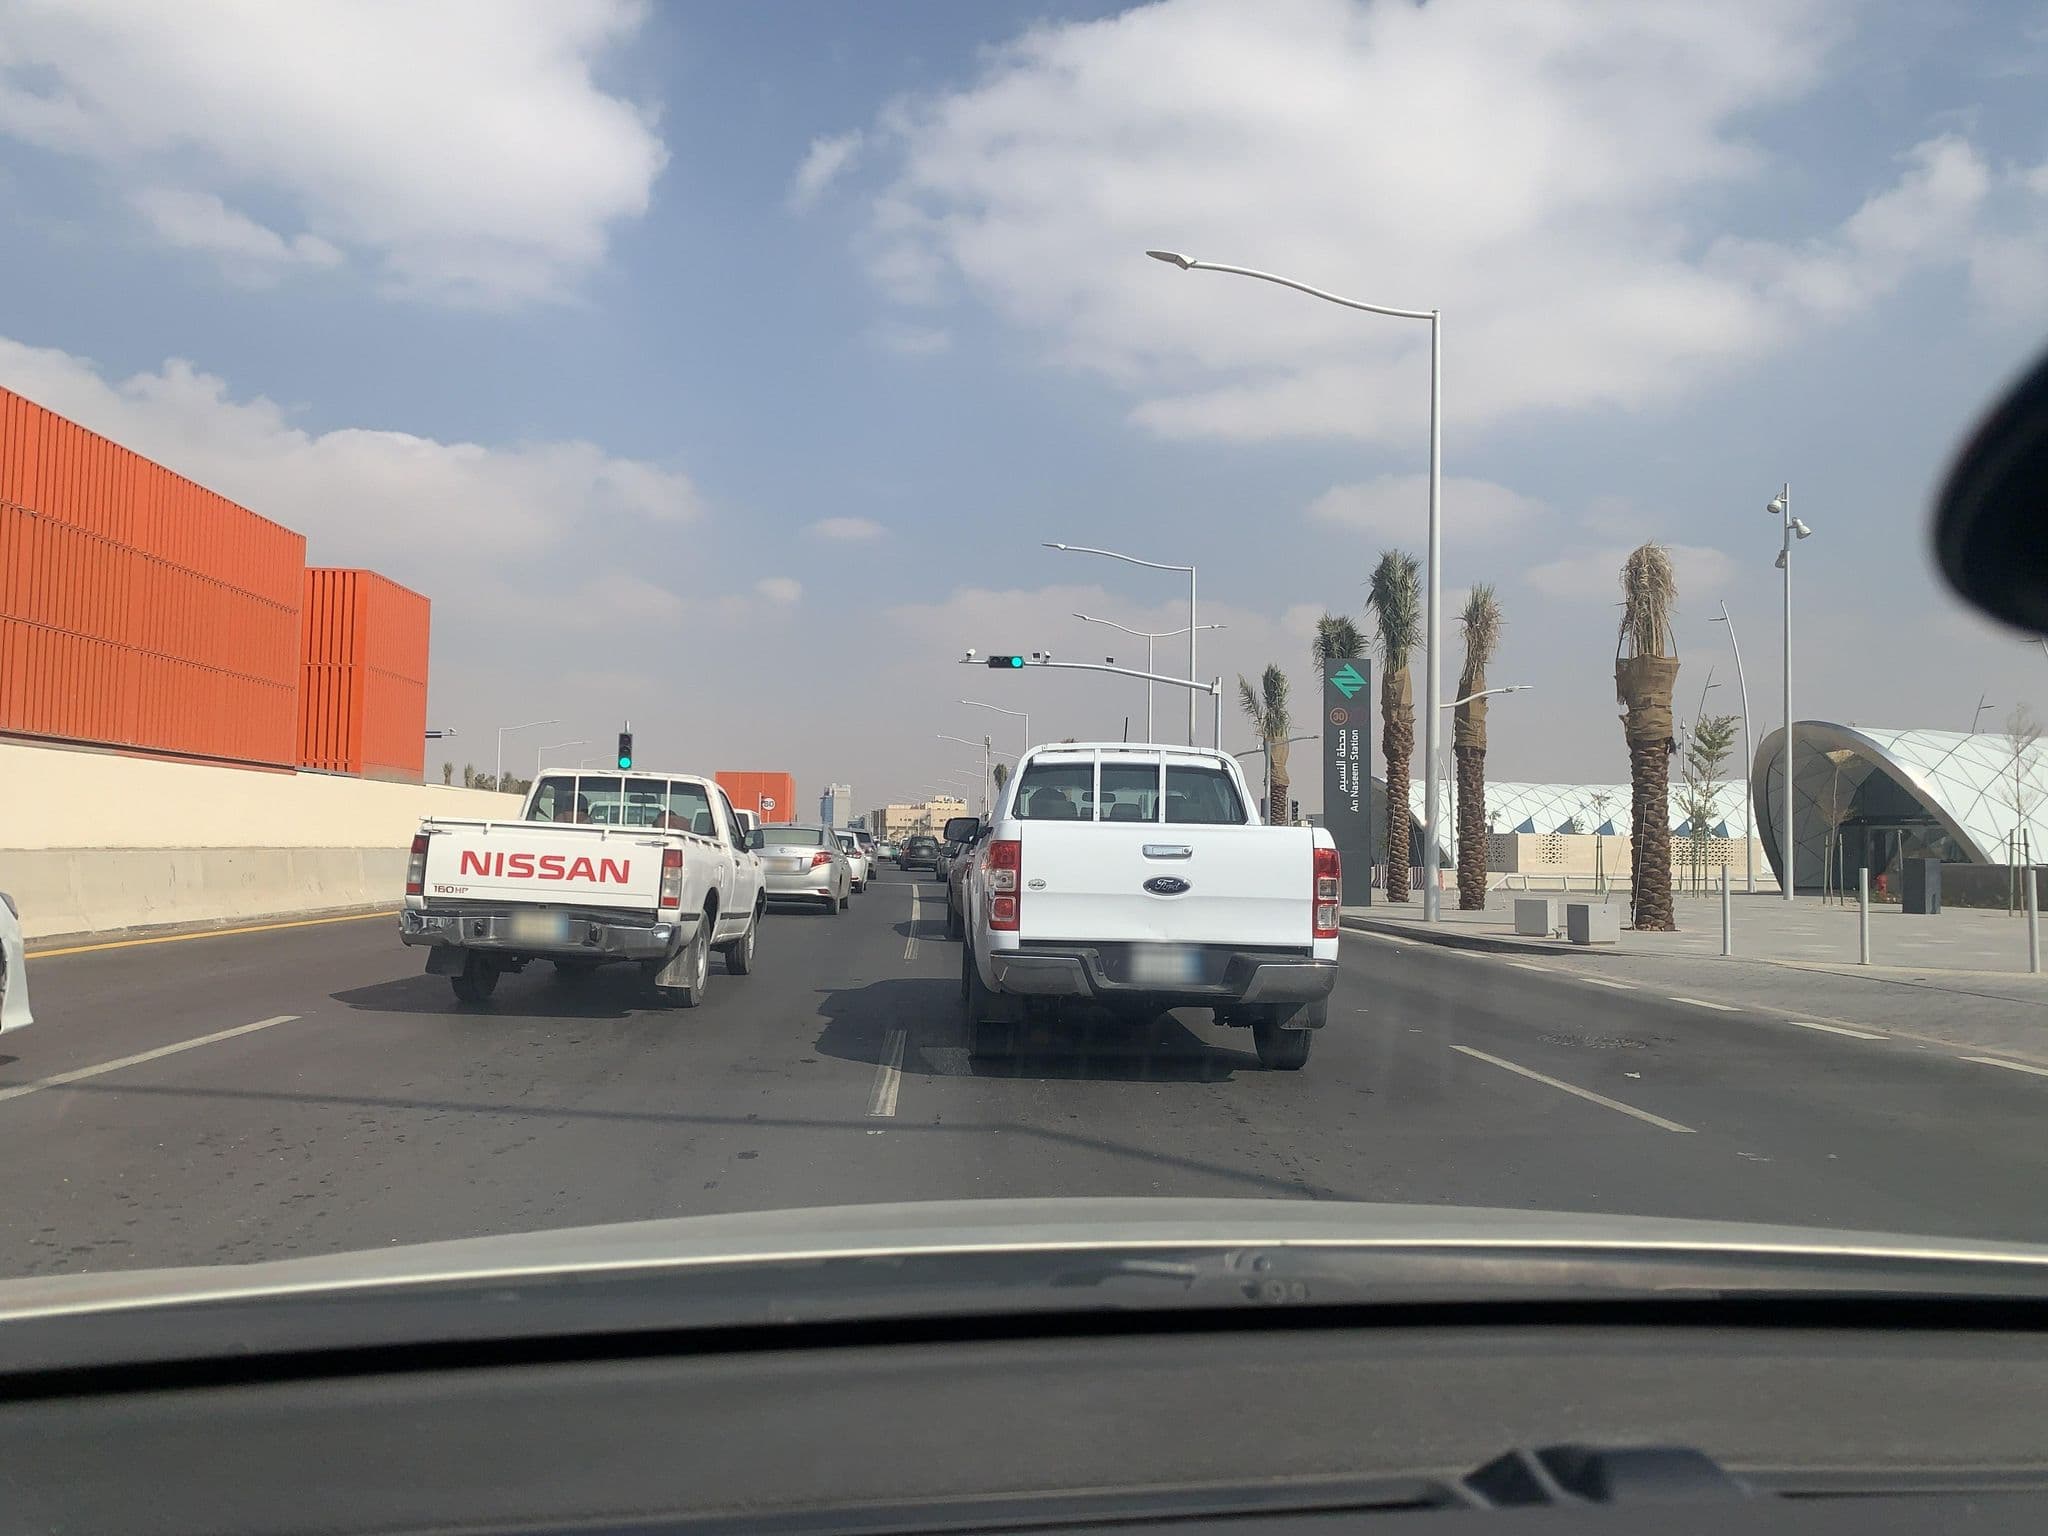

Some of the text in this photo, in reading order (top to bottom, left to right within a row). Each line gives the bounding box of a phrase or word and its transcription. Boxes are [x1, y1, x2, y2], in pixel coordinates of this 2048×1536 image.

[1335, 729, 1349, 792] محطة النسيم
[1350, 729, 1359, 812] An Naseem Station
[460, 850, 630, 884] NISSAN
